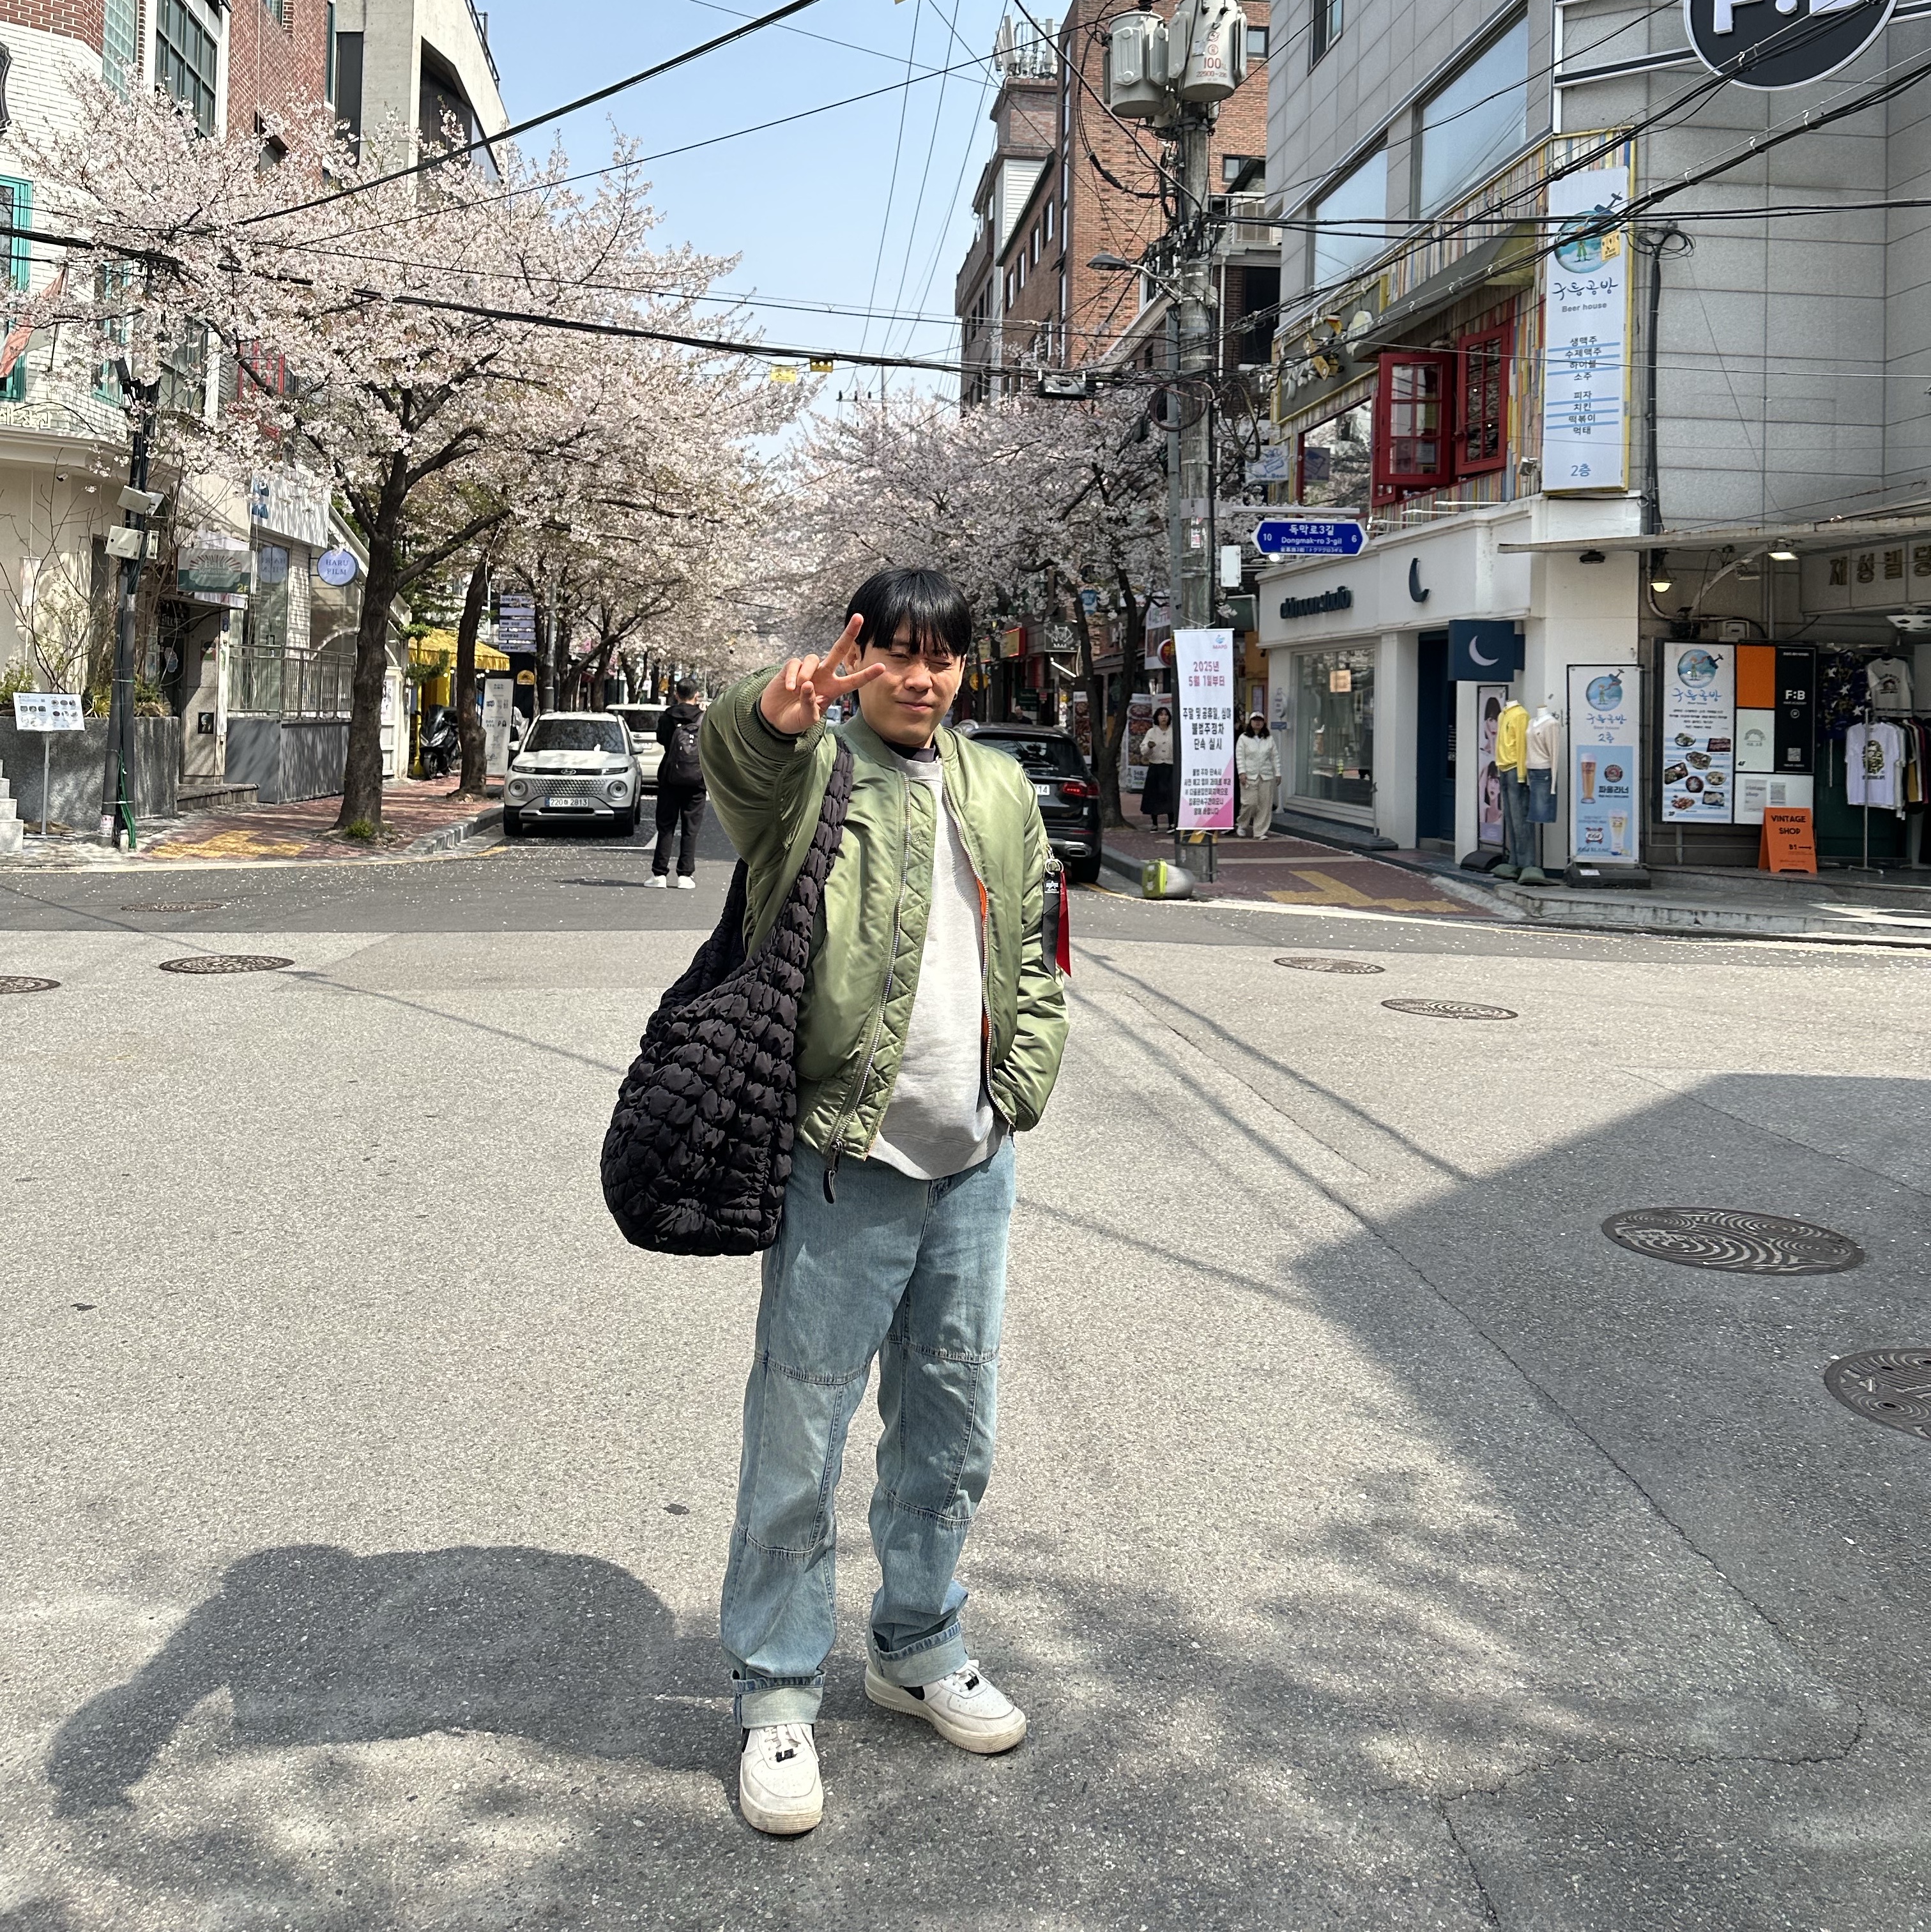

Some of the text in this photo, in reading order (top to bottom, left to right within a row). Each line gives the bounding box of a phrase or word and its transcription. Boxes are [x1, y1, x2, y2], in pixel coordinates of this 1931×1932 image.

[1204, 57, 1221, 69] 100
[1569, 336, 1598, 347] 생맥주
[1565, 347, 1602, 358] 수제맥주
[1574, 372, 1592, 381] 소주
[1573, 390, 1592, 400] 피자
[1573, 402, 1592, 412] 치킨
[1568, 413, 1596, 423] 떡볶이
[1571, 463, 1591, 478] 2층
[1288, 524, 1335, 536] 독막로3길
[1281, 536, 1342, 545] Dongmak-ro 3-gil
[326, 558, 349, 567] HARU
[237, 584, 249, 593] 2F
[1193, 660, 1219, 672] 2025년
[1188, 675, 1225, 687] 5월 1일부터
[1785, 689, 1806, 701] F:B
[1183, 707, 1194, 720] 주말
[1196, 707, 1201, 719] 및
[1191, 722, 1225, 735] 불법주정차
[1194, 738, 1223, 750] 단속 실시
[1598, 786, 1630, 794] 파울라너
[1771, 814, 1806, 823] VINTAGE
